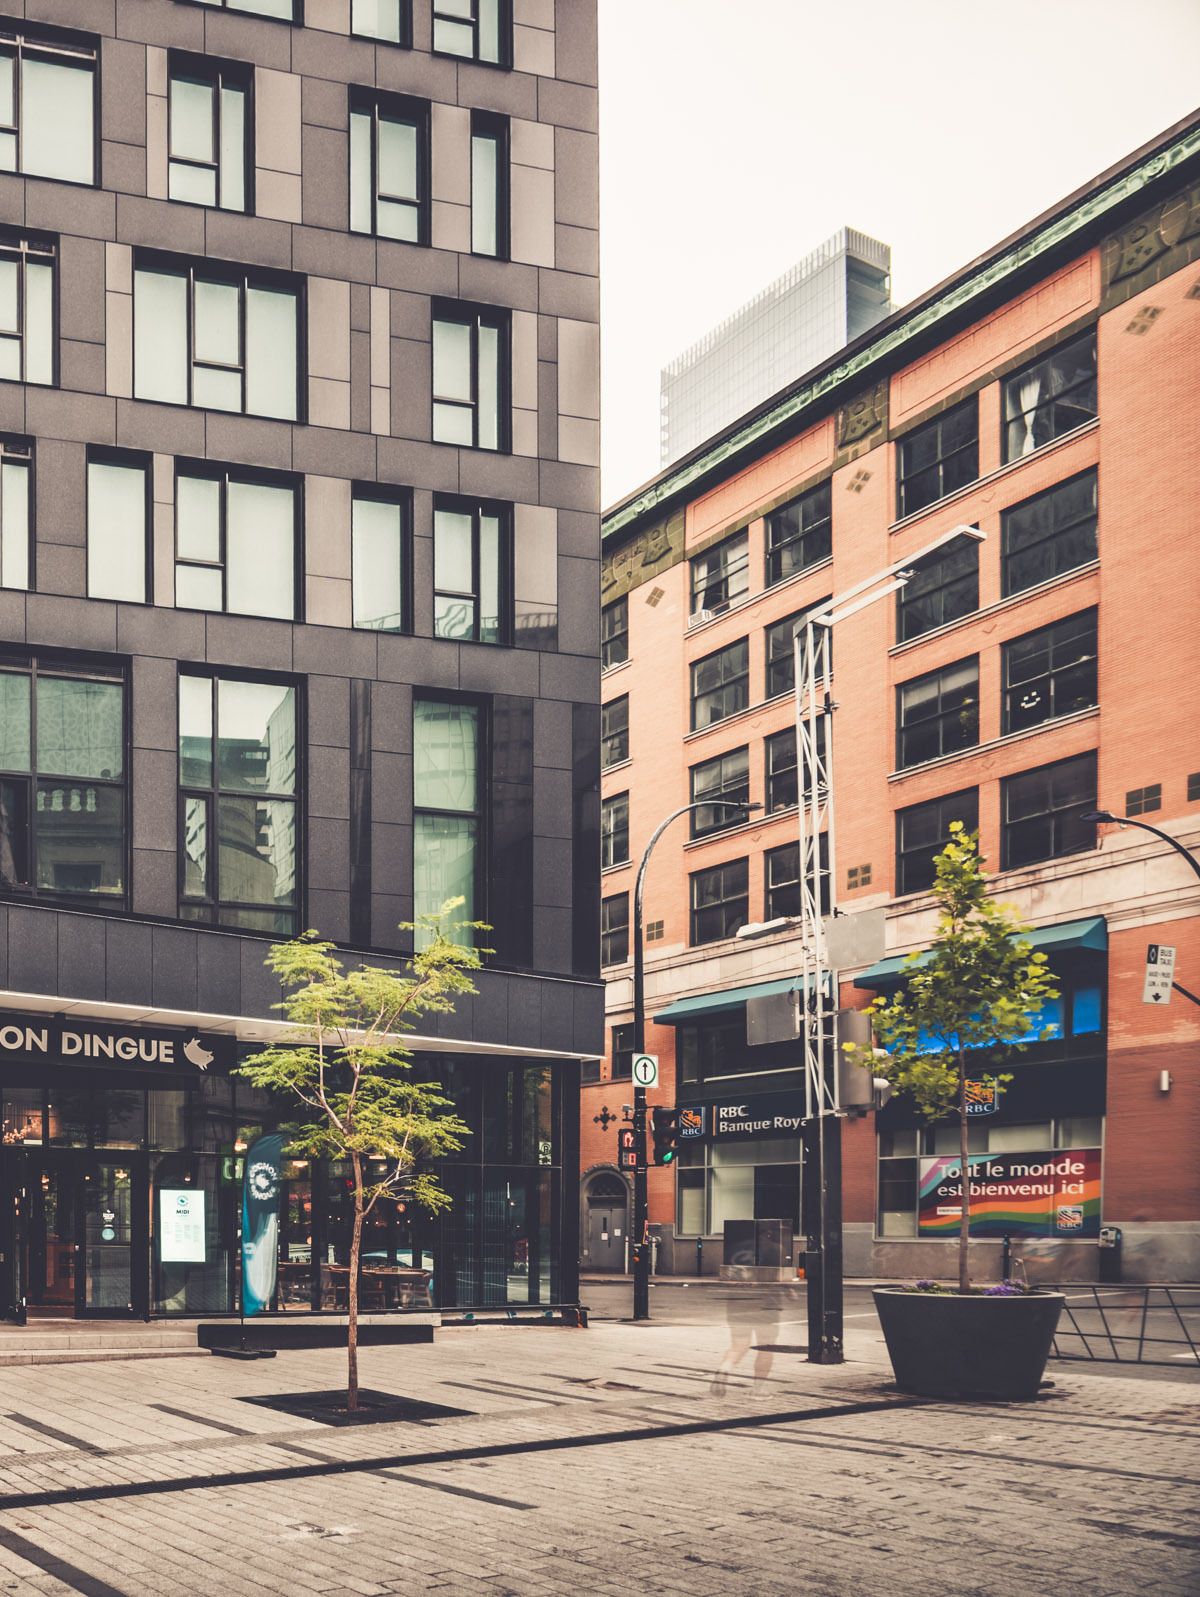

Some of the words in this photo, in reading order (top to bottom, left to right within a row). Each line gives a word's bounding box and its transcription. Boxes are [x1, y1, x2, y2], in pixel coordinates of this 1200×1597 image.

[61, 1031, 175, 1064] DINGUE
[720, 1105, 749, 1119] RBC
[965, 1103, 992, 1113] RBC
[682, 1128, 700, 1136] RBC
[720, 1120, 772, 1133] Banque
[774, 1116, 807, 1130] Roya
[986, 1161, 1004, 1177] le
[1010, 1158, 1085, 1177] monde
[937, 1183, 963, 1197] est
[970, 1181, 1054, 1196] bienvenu
[1061, 1180, 1085, 1194] ici
